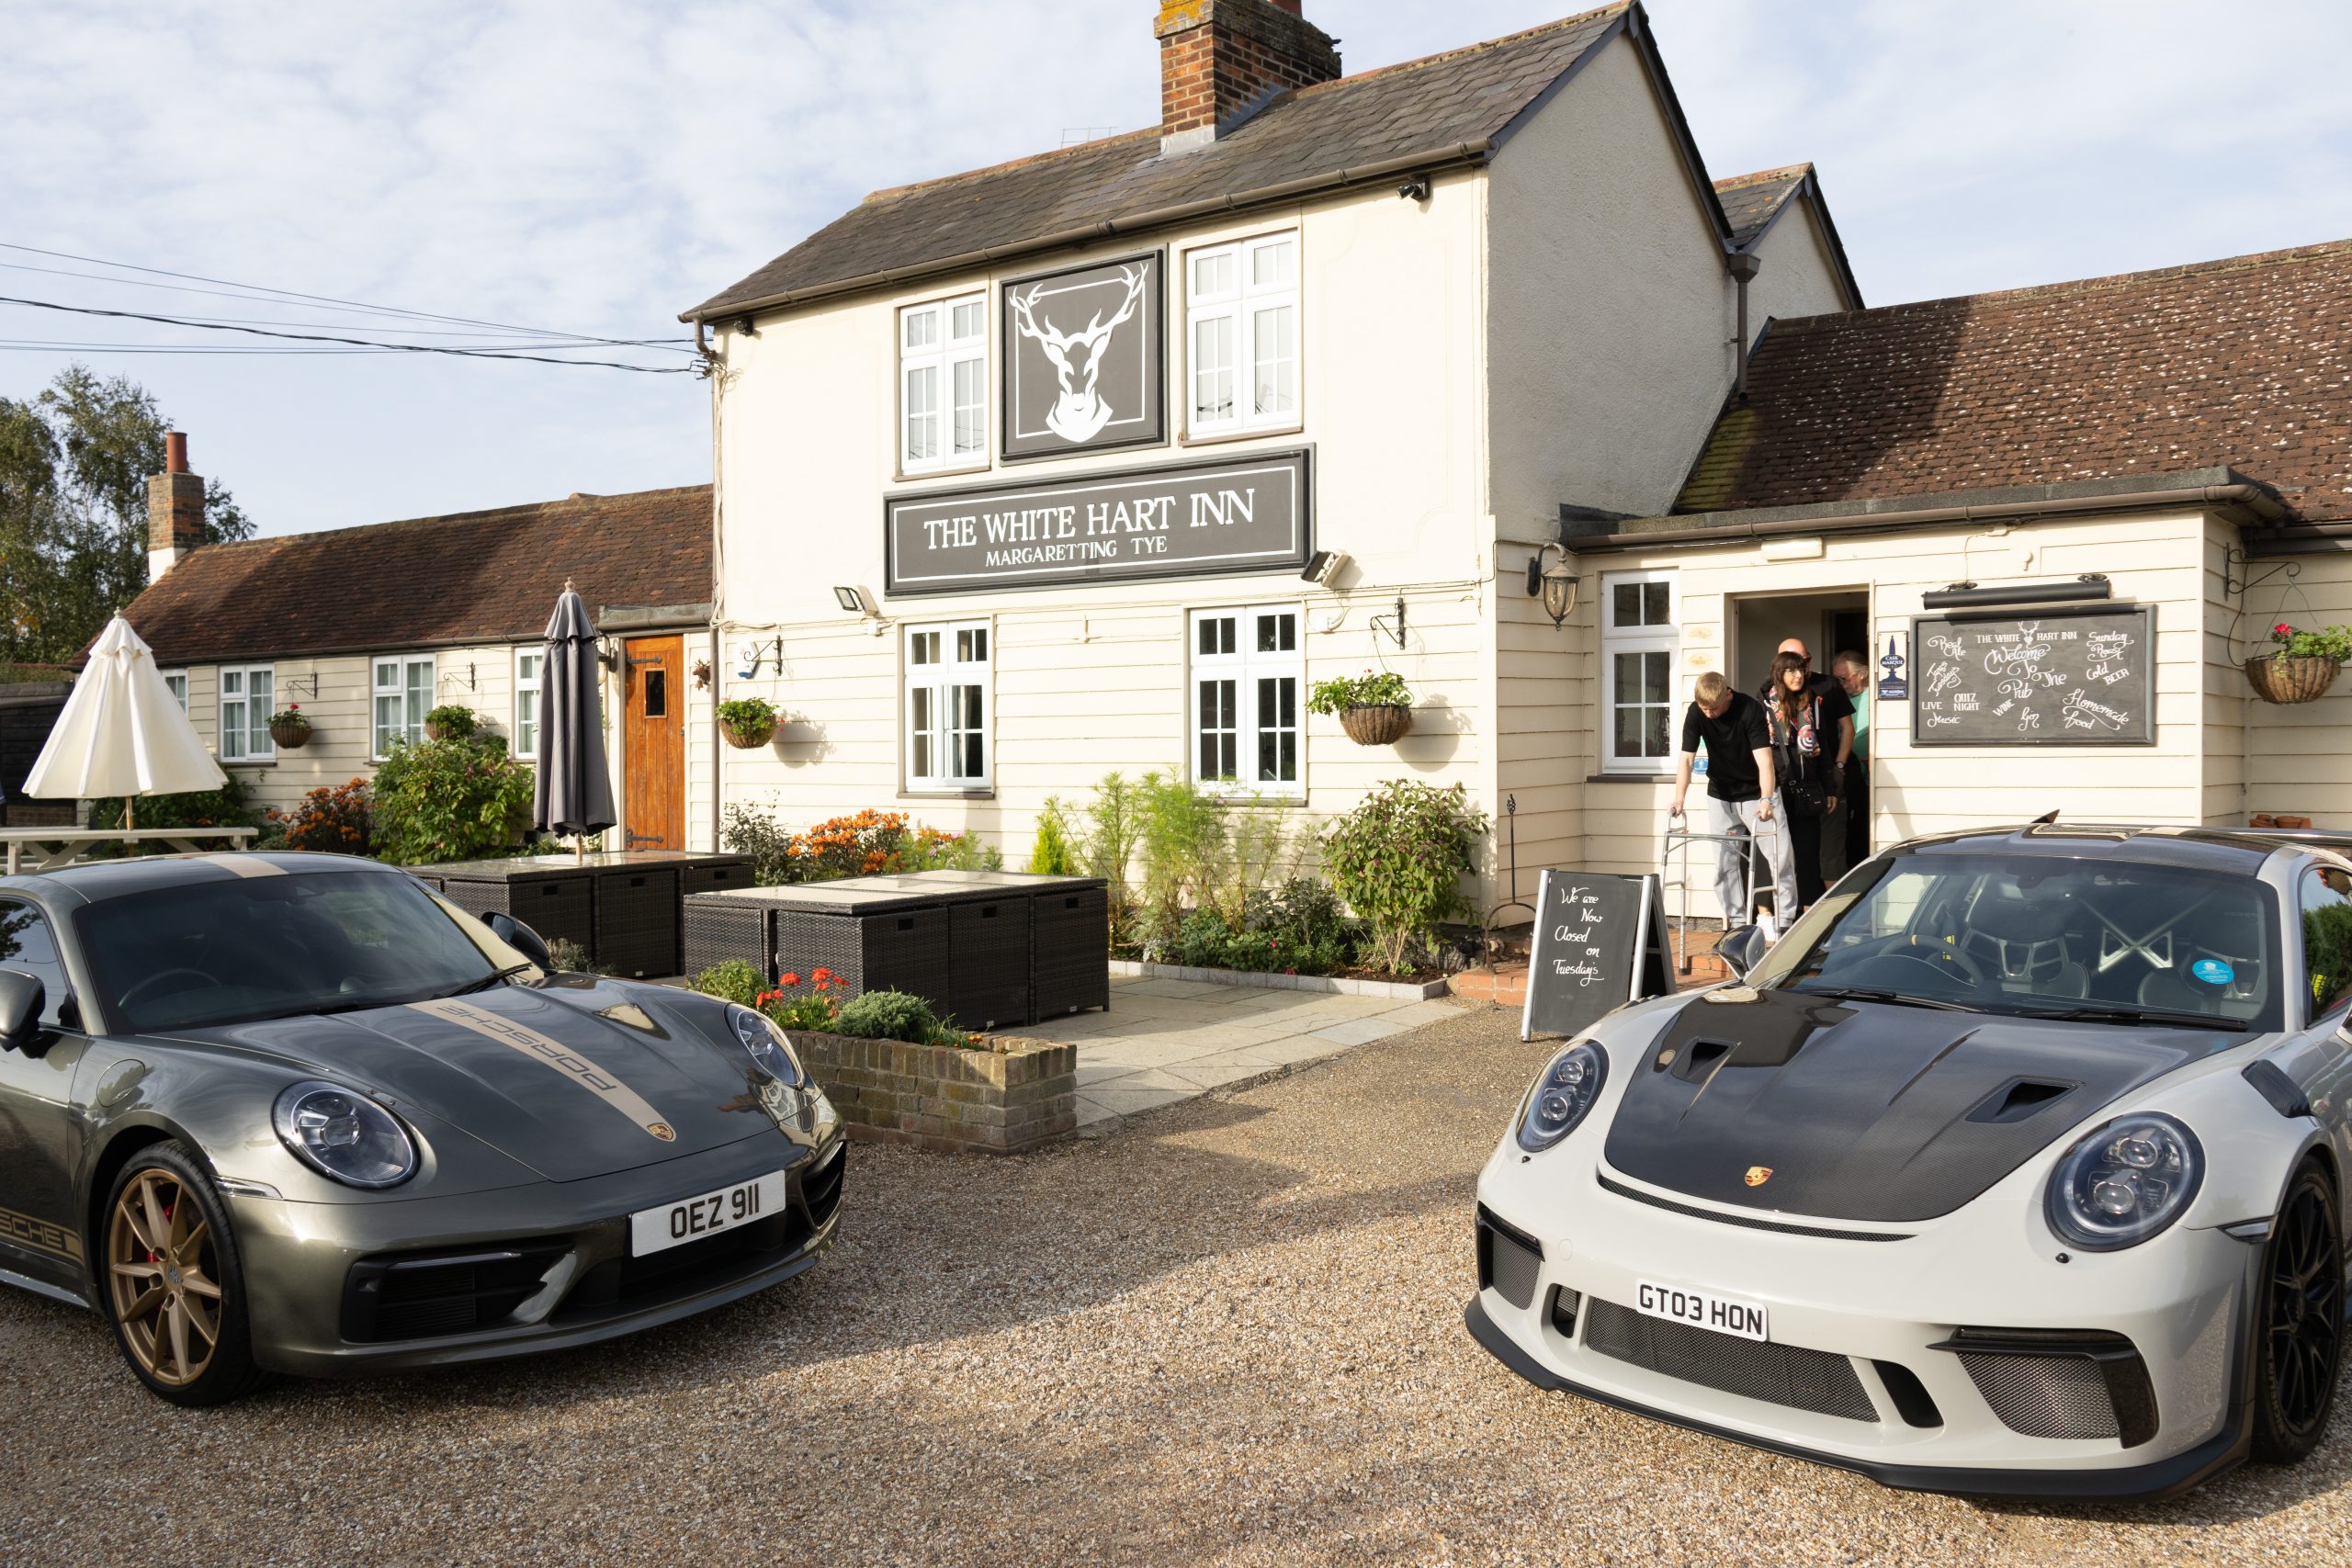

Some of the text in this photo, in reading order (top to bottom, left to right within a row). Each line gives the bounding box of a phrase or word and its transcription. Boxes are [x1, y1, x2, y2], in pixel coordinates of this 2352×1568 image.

[923, 488, 1255, 549] THE WHITE HART INN
[986, 536, 1168, 567] MARGARETTING TYE
[1928, 636, 1962, 649] Real
[1976, 631, 2077, 643] THE WHITE HART INN
[2086, 630, 2134, 649] Sunday
[1943, 645, 1966, 660] Ale
[2086, 644, 2124, 661] Roast
[2007, 660, 2038, 679] To
[2031, 669, 2066, 687] The
[2086, 661, 2109, 680] Cold
[2102, 668, 2130, 685] BEER
[1997, 679, 2032, 698] Pub
[1953, 693, 1977, 703] QUIZ
[2062, 688, 2129, 725] Homemade
[1953, 703, 1981, 711] NIGHT
[1992, 699, 2015, 716] WINE
[1927, 712, 1962, 728] Music
[1561, 886, 1599, 904] We are
[1581, 908, 1603, 923] Now
[1555, 925, 1591, 942] Closed
[1586, 946, 1600, 957] on
[436, 1005, 617, 1091] PORSCHE
[671, 1182, 760, 1238] OEZ 911
[1639, 1283, 1762, 1335] GT03 HON
